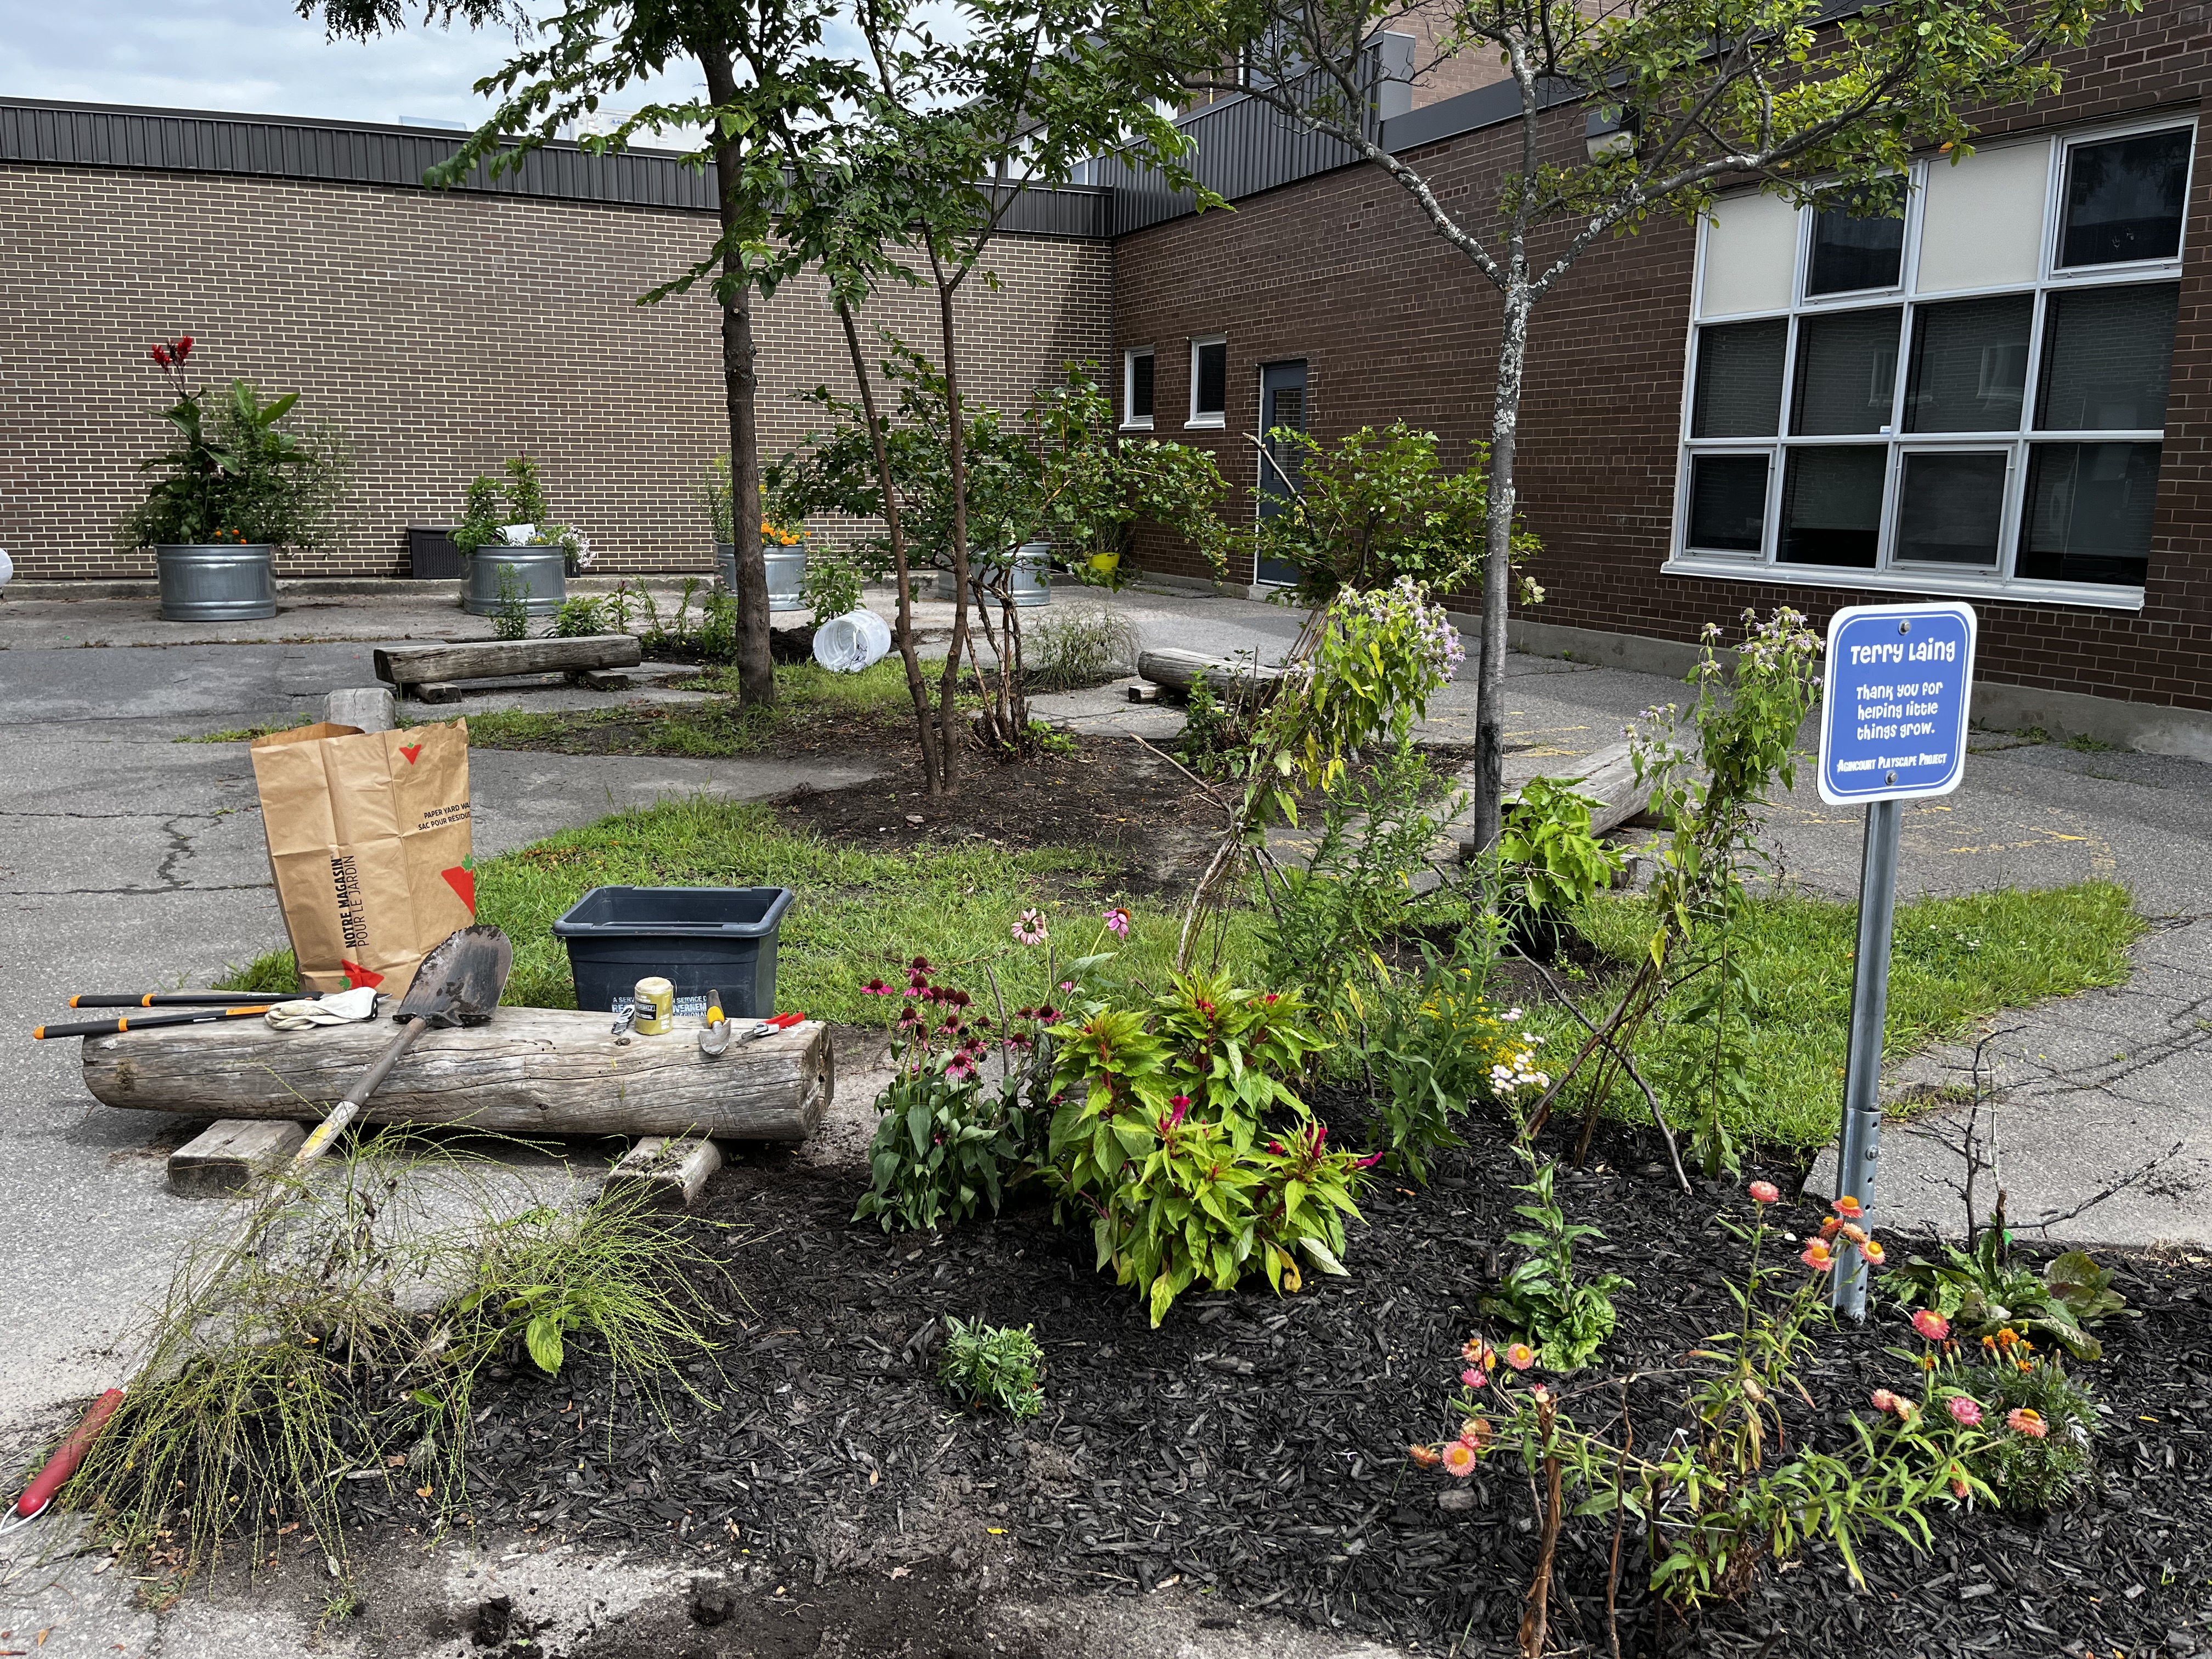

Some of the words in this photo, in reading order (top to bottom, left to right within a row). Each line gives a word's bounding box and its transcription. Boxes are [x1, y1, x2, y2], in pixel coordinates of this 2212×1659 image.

[1850, 644, 1904, 665] Terry
[1909, 637, 1955, 662] Laing
[1857, 684, 1893, 701] Thank
[1897, 684, 1919, 697] you
[1922, 682, 1943, 696] for
[1858, 703, 1902, 720] helping
[1906, 701, 1938, 716] little
[1857, 723, 1898, 741] things
[1900, 722, 1935, 738] grow.
[424, 809, 443, 819] PAPER
[443, 805, 460, 814] YARD
[431, 818, 447, 827] POUR
[331, 858, 349, 908] MAGASIN
[342, 856, 360, 895] JARDIN
[350, 899, 363, 912] LE
[340, 911, 357, 948] NOTRE
[353, 916, 369, 946] POUR
